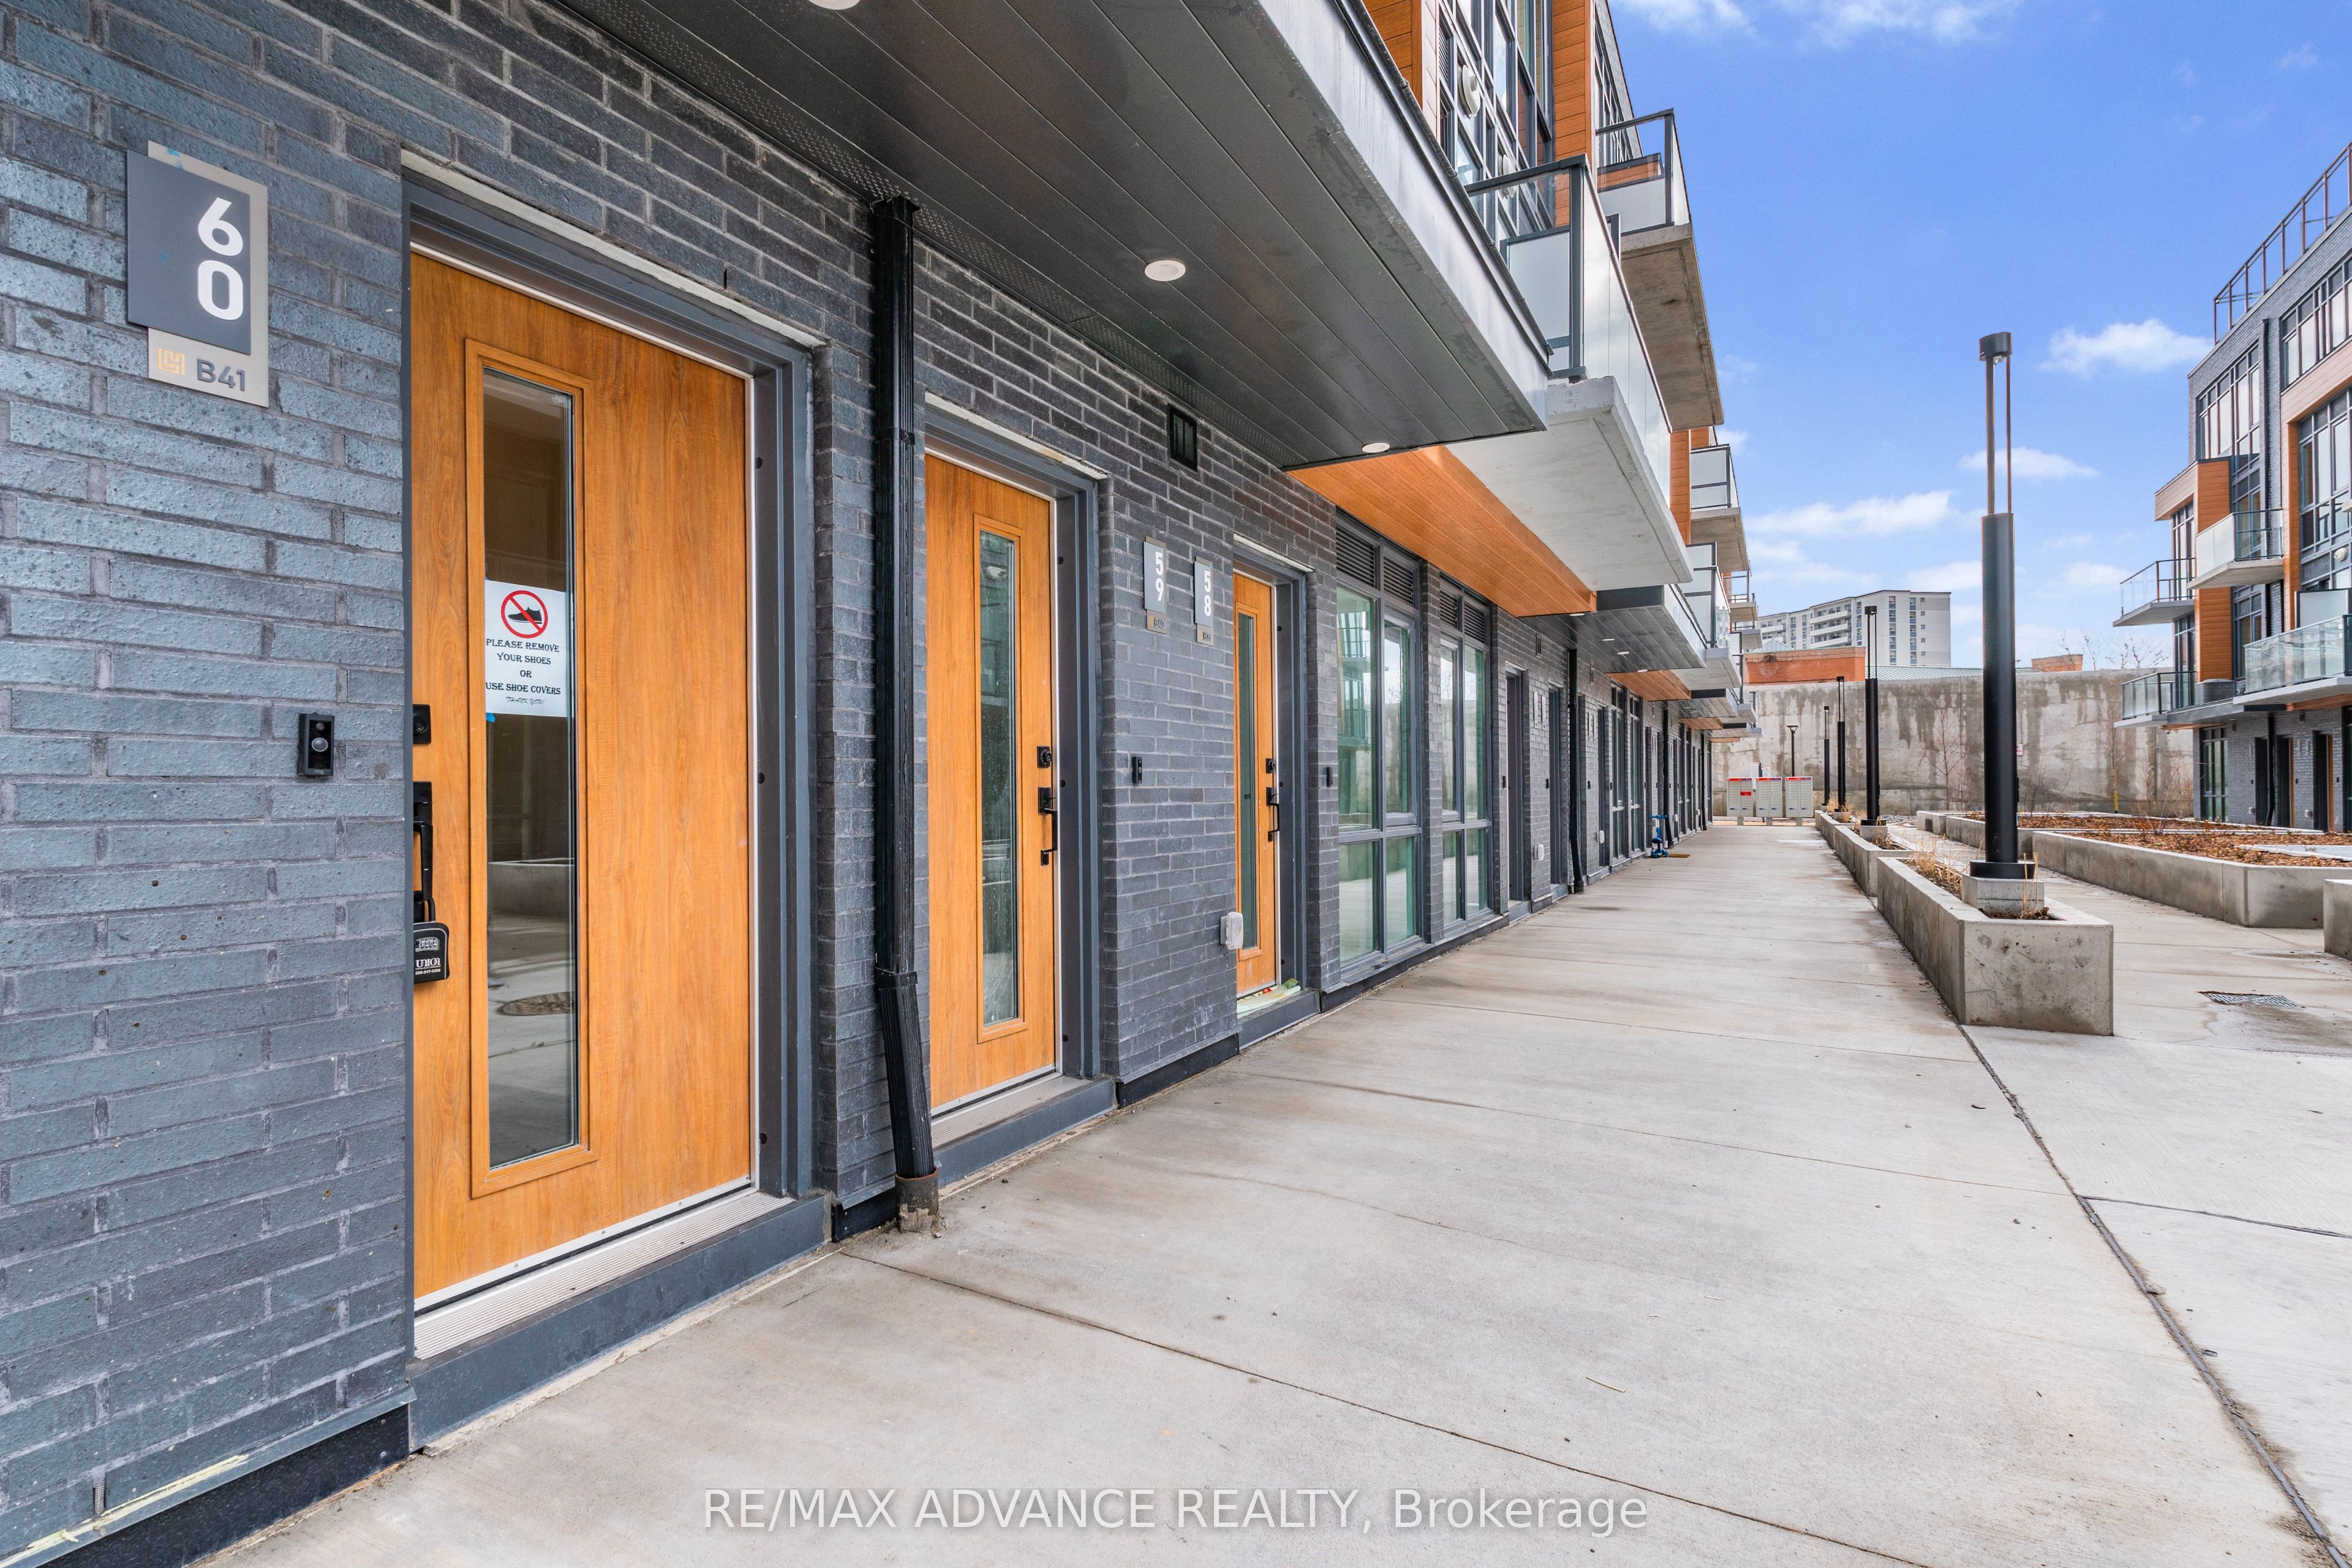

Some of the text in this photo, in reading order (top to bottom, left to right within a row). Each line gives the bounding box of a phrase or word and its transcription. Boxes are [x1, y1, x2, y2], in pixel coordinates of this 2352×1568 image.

[198, 197, 243, 320] 60
[197, 358, 245, 391] B41
[1155, 551, 1164, 601] 59
[1204, 570, 1212, 616] 58
[486, 638, 560, 652] PLEASE REMOVE
[497, 652, 551, 665] YOUR SHOES
[519, 669, 532, 678] OR
[506, 684, 529, 692] SHOE
[530, 685, 561, 695] COVERS
